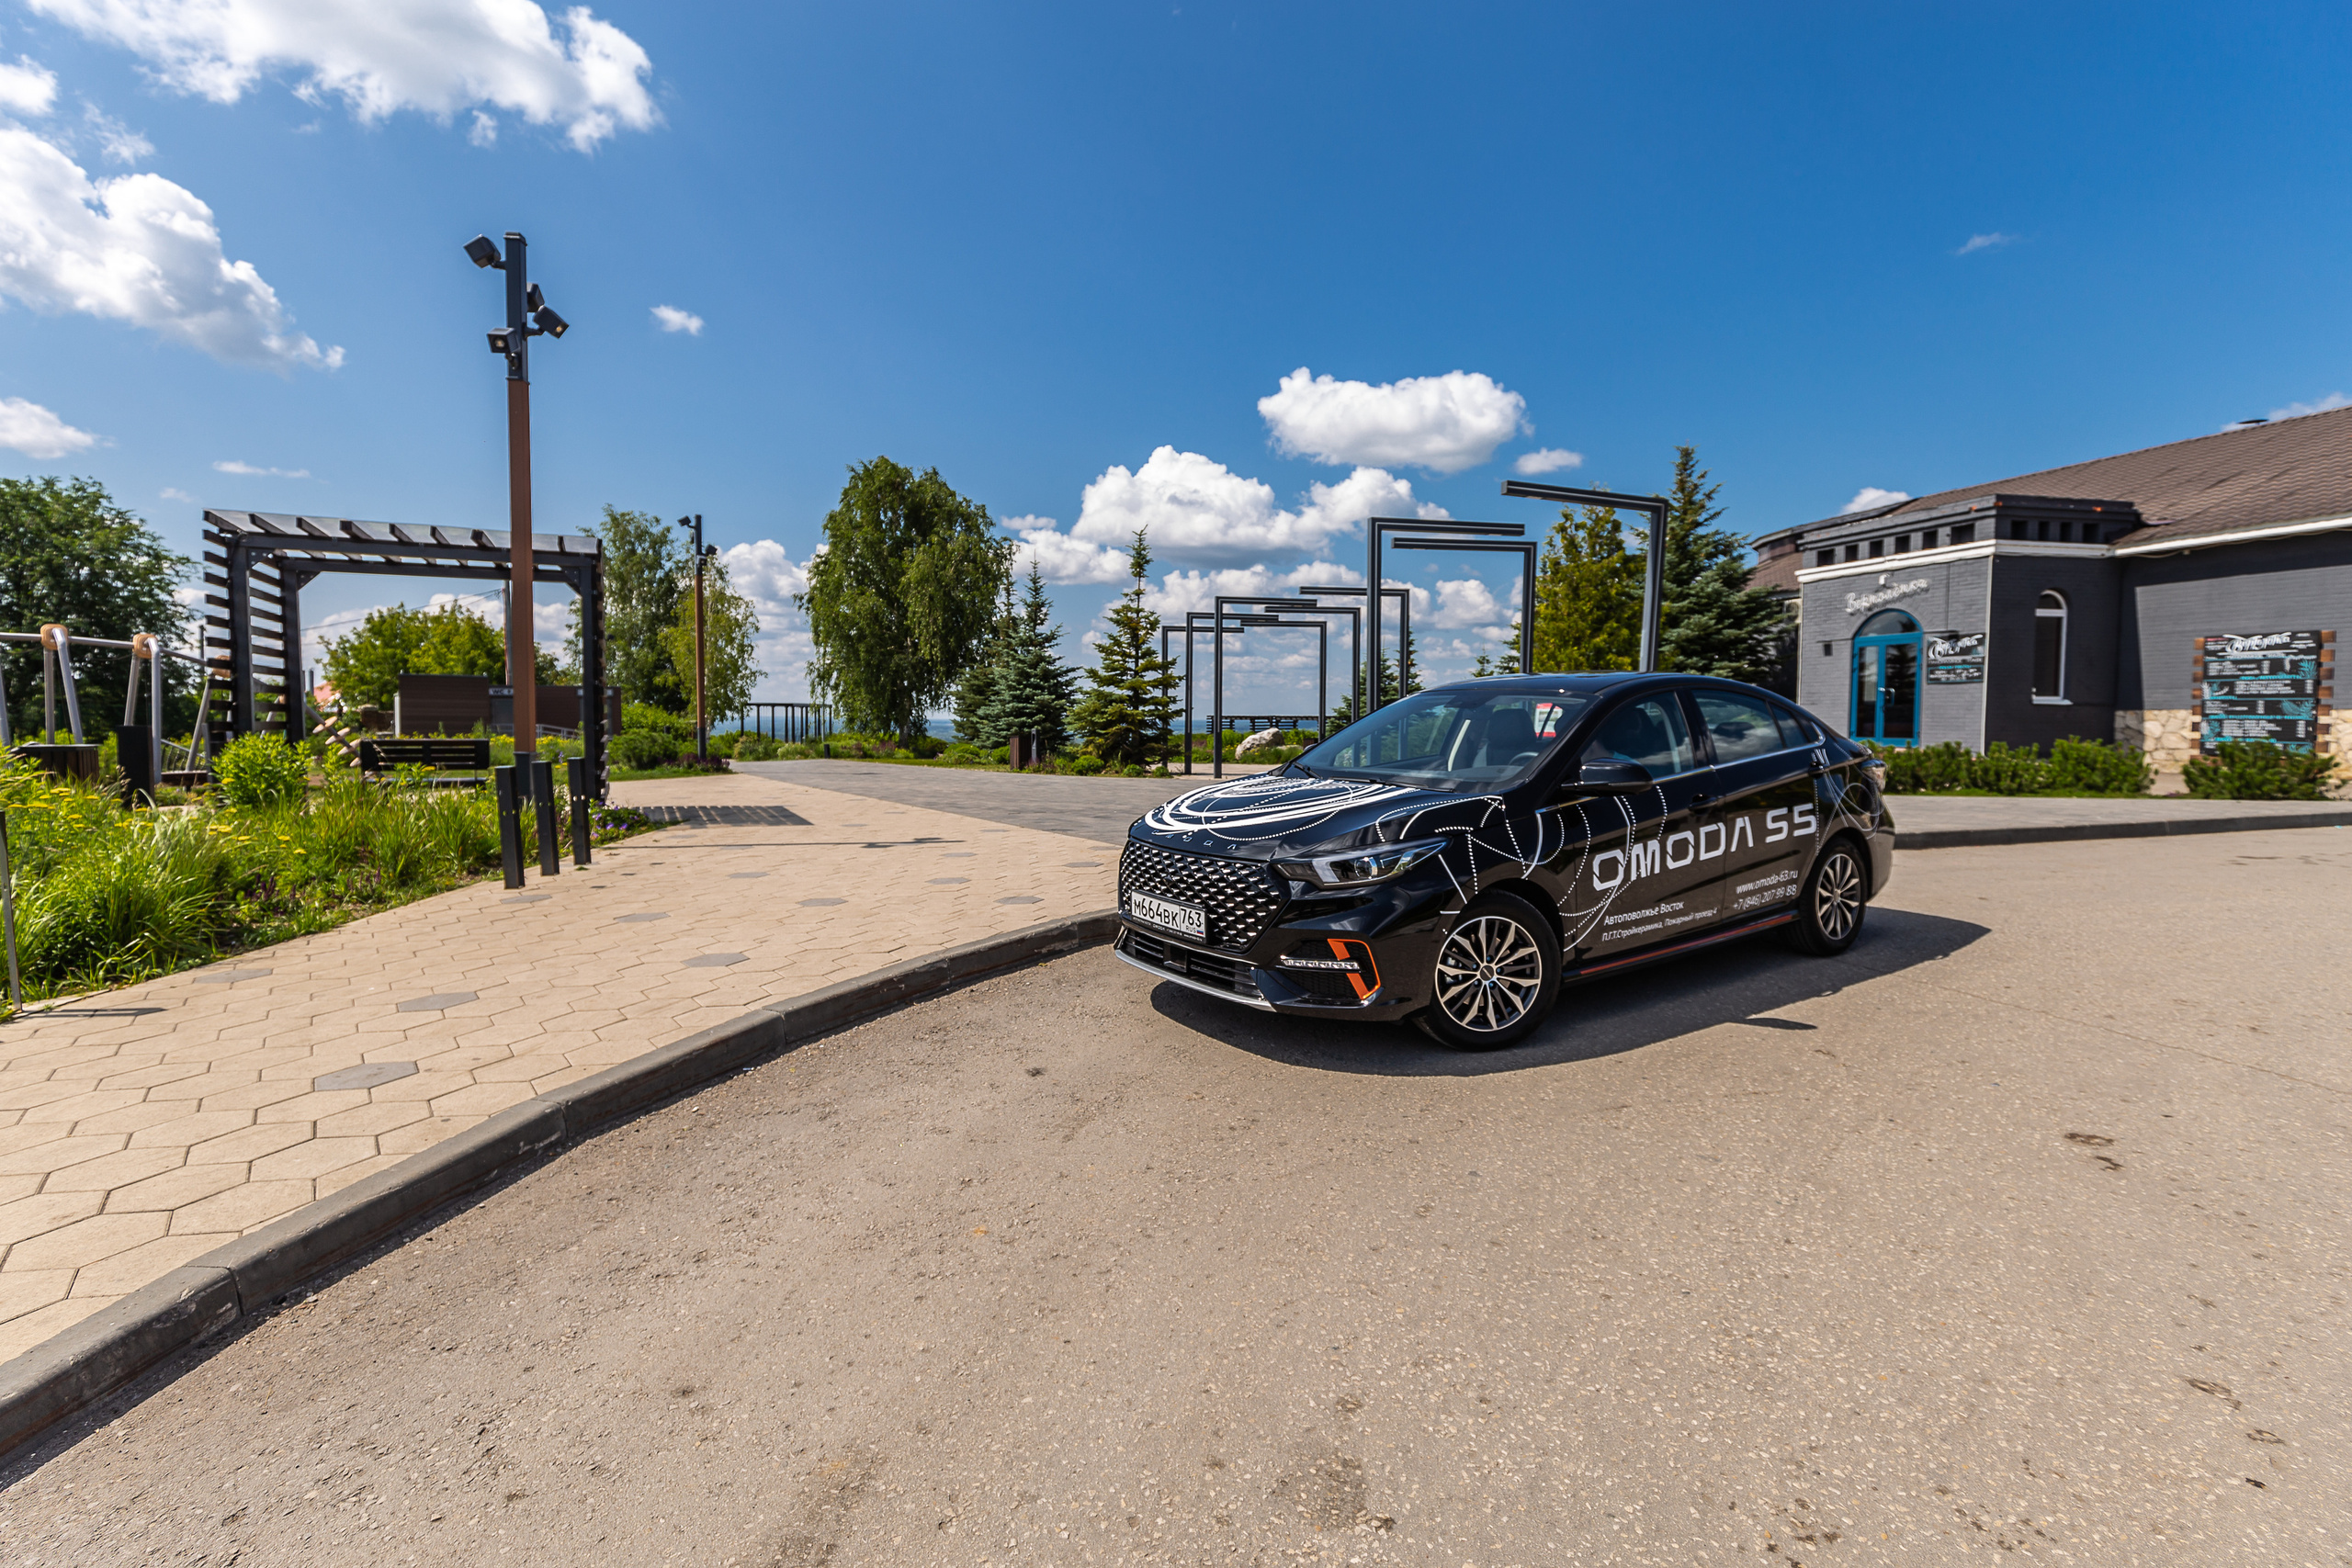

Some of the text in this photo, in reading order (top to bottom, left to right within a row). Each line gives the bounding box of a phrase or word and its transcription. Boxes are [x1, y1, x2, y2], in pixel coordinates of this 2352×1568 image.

[1593, 816, 1754, 891] OMODA
[1736, 869, 1799, 895] www.omoda-63.ru
[1733, 884, 1797, 911] +7 (846) 207 99 88
[1181, 908, 1202, 927] 763
[1603, 900, 1685, 926] Автоповолжье Восток
[1185, 925, 1197, 934] RUS
